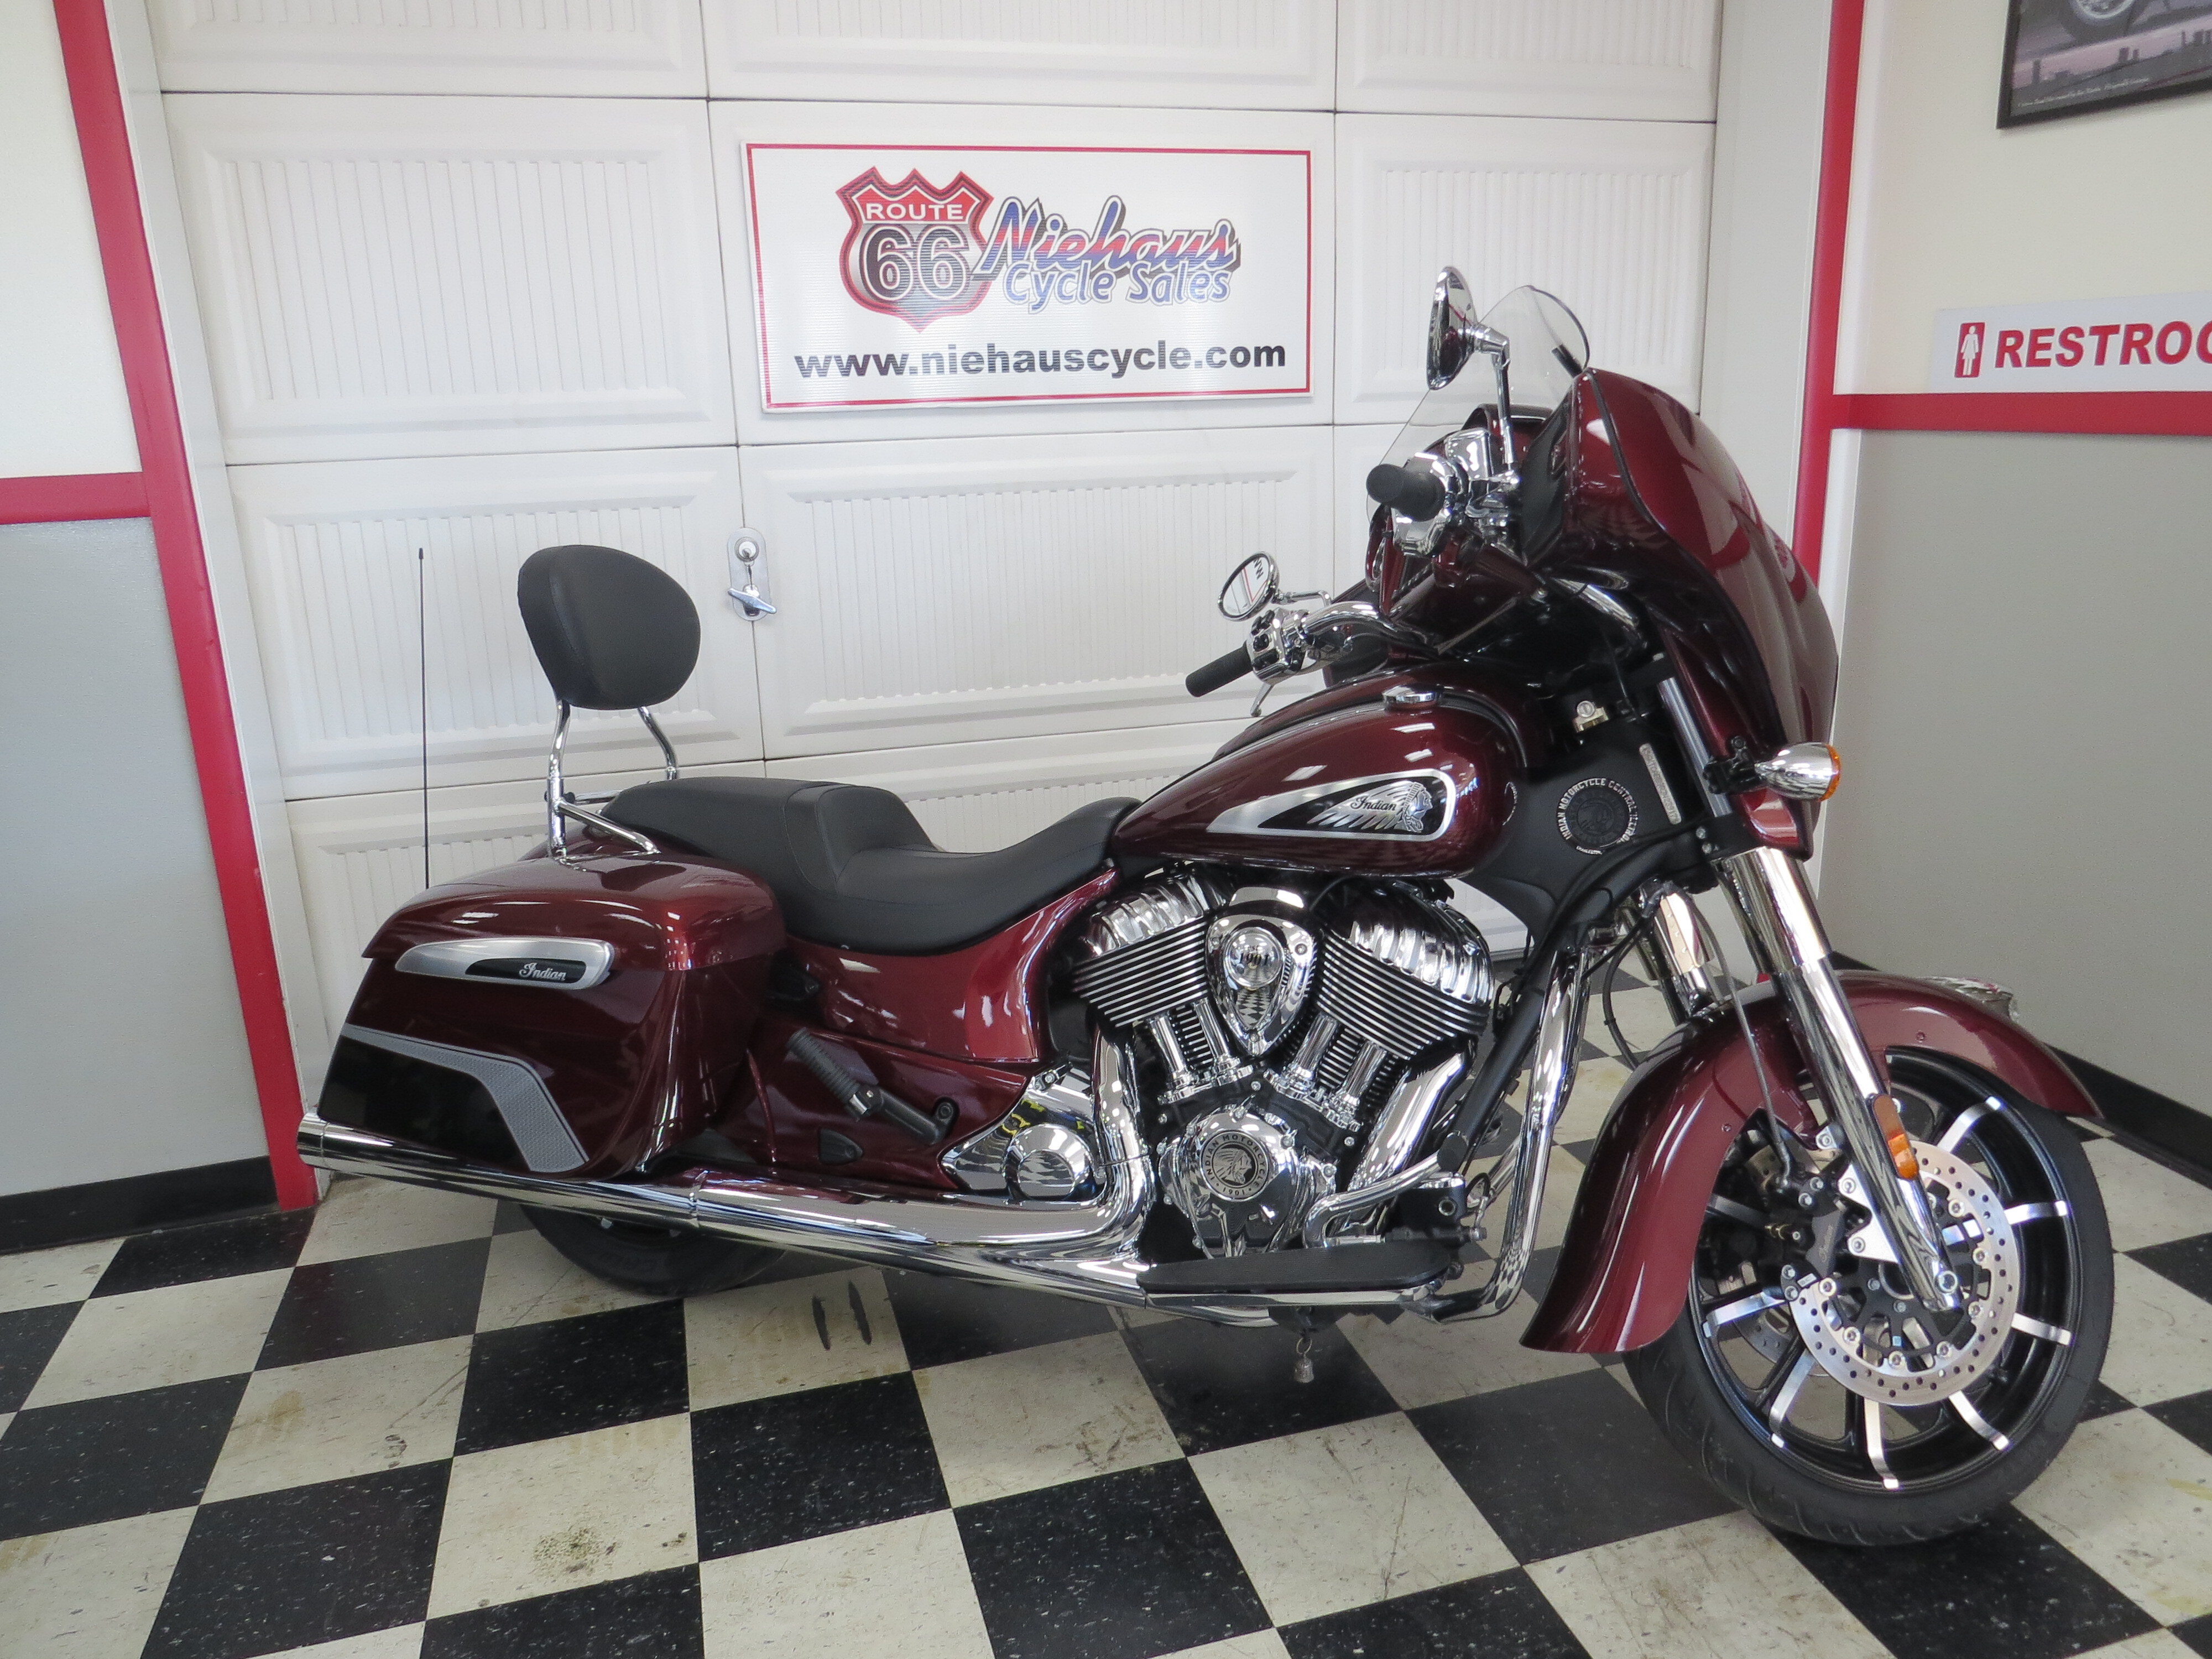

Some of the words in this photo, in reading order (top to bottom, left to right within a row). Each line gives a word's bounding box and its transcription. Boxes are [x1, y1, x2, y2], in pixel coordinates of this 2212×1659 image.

[865, 203, 964, 220] ROUTE
[972, 196, 1240, 281] Niehaus
[859, 223, 969, 301] 66
[1003, 260, 1116, 314] Cycle
[1125, 261, 1231, 306] Sales
[795, 341, 1286, 378] www.niehauscycle.com
[1350, 796, 1396, 811] Indian
[1558, 778, 1606, 811] MOTORCYCLE
[1557, 812, 1572, 839] INDIAN
[519, 962, 567, 982] Indian
[1206, 1141, 1219, 1181] INDIAN
[1222, 1135, 1265, 1188] MOTORCYCLE
[1223, 1186, 1245, 1196] 1901
